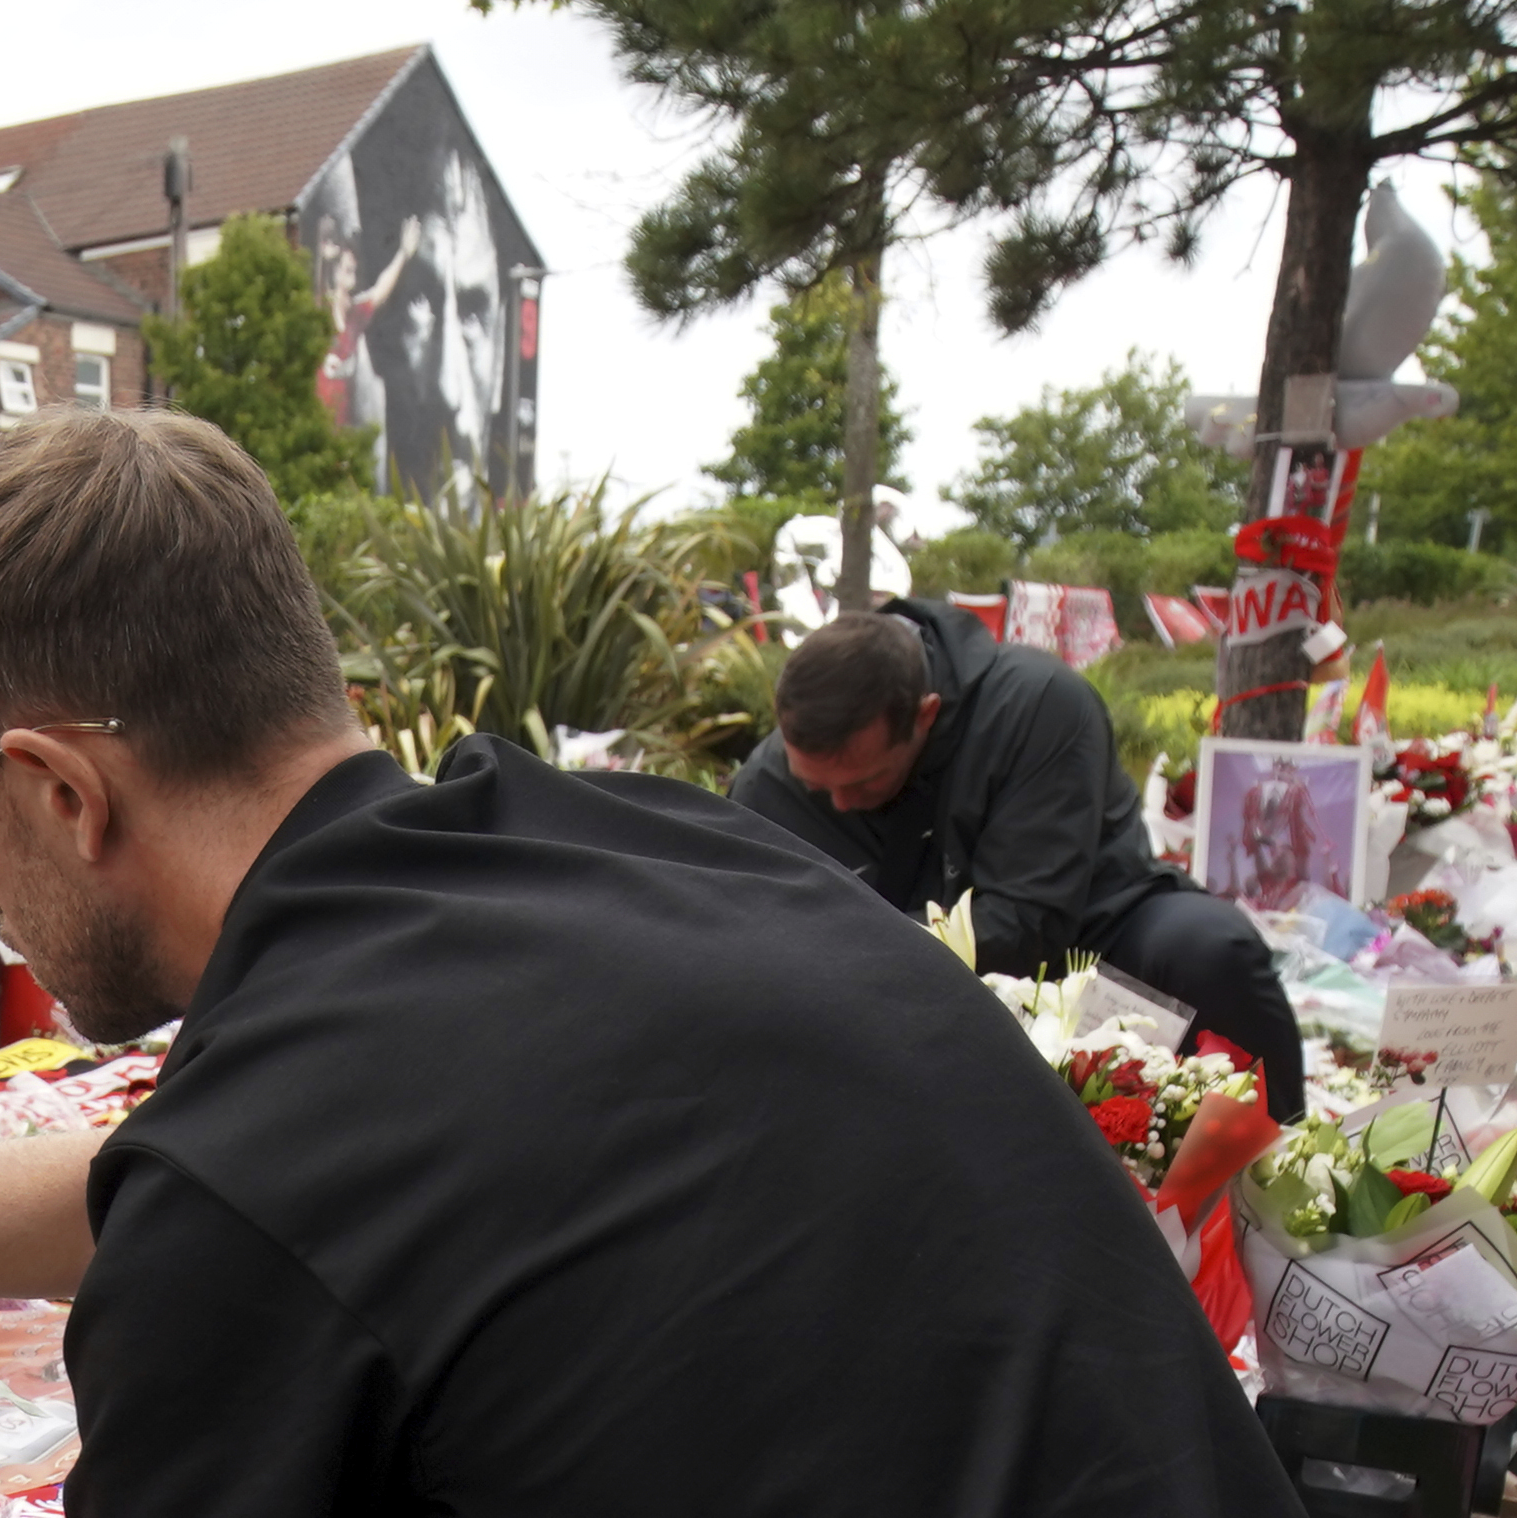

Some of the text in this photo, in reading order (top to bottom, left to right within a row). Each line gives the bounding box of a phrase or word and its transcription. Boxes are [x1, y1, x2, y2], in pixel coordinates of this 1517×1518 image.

[1271, 1311, 1364, 1376] SHOP
[1276, 1293, 1371, 1363] FLOWER
[1284, 1273, 1379, 1347] DUTCH
[1446, 1355, 1517, 1380] DUT
